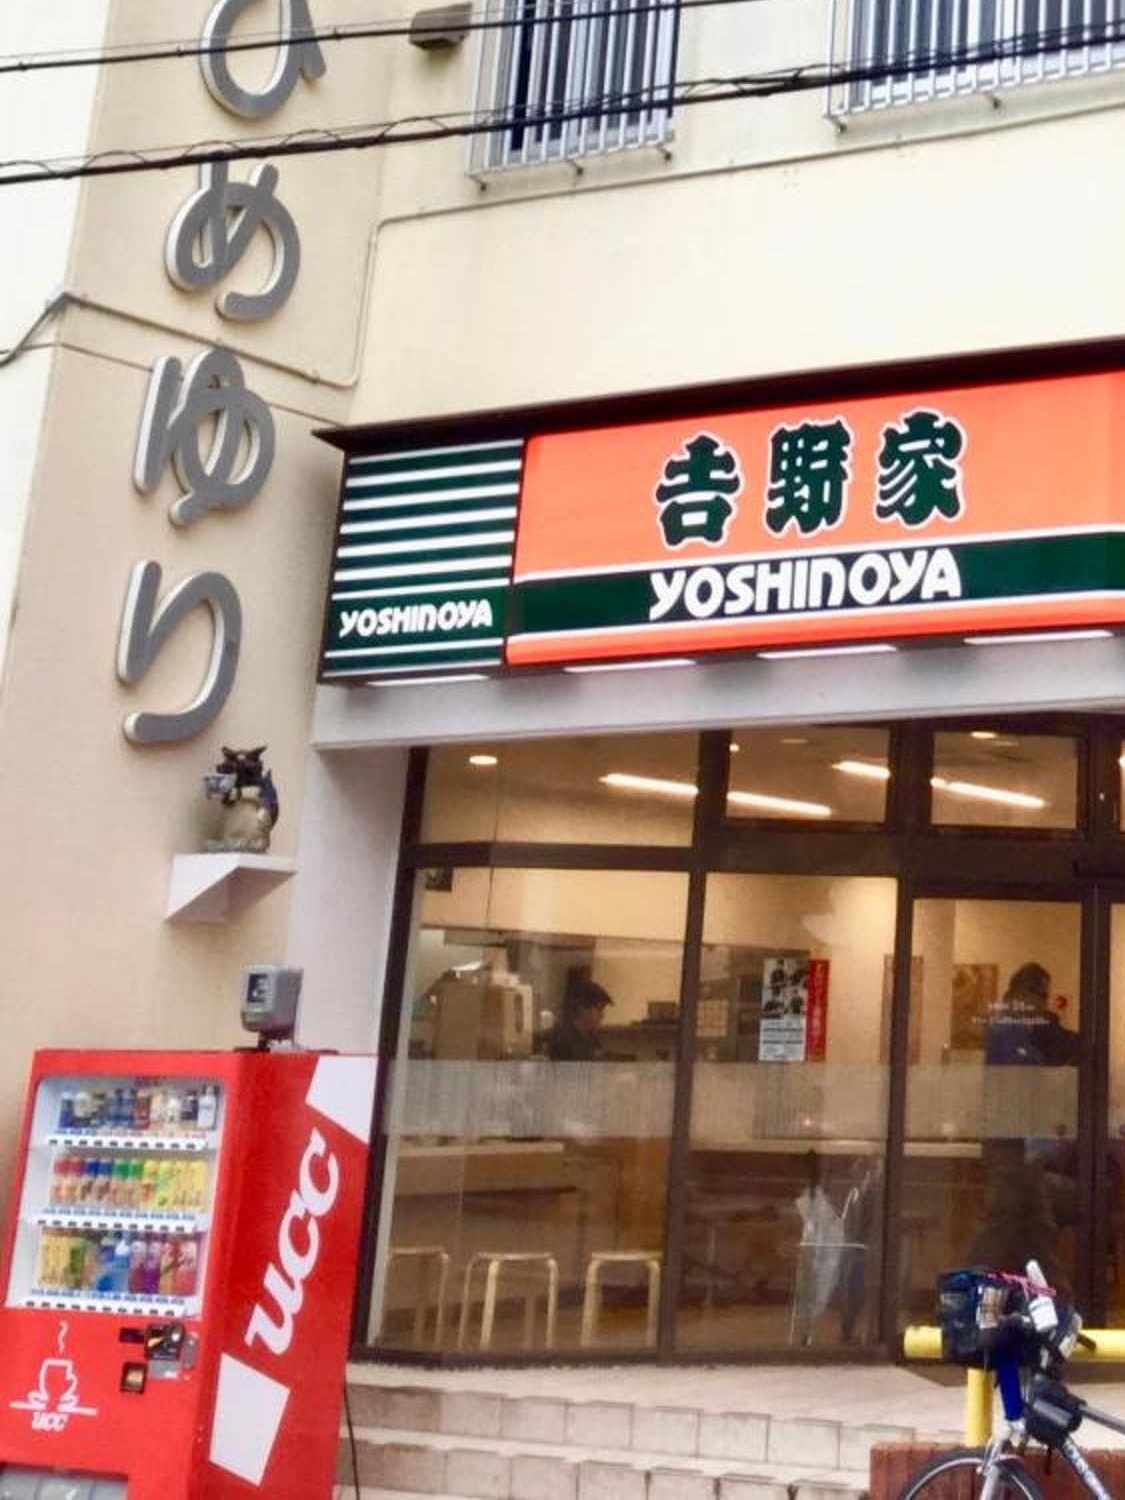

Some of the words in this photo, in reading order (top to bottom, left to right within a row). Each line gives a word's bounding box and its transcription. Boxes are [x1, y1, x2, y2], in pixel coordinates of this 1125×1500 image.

[655, 408, 964, 547] 吉野家
[338, 598, 494, 639] YOSHINOYA
[648, 547, 963, 622] YOSHINOYA
[244, 1126, 340, 1356] UCC
